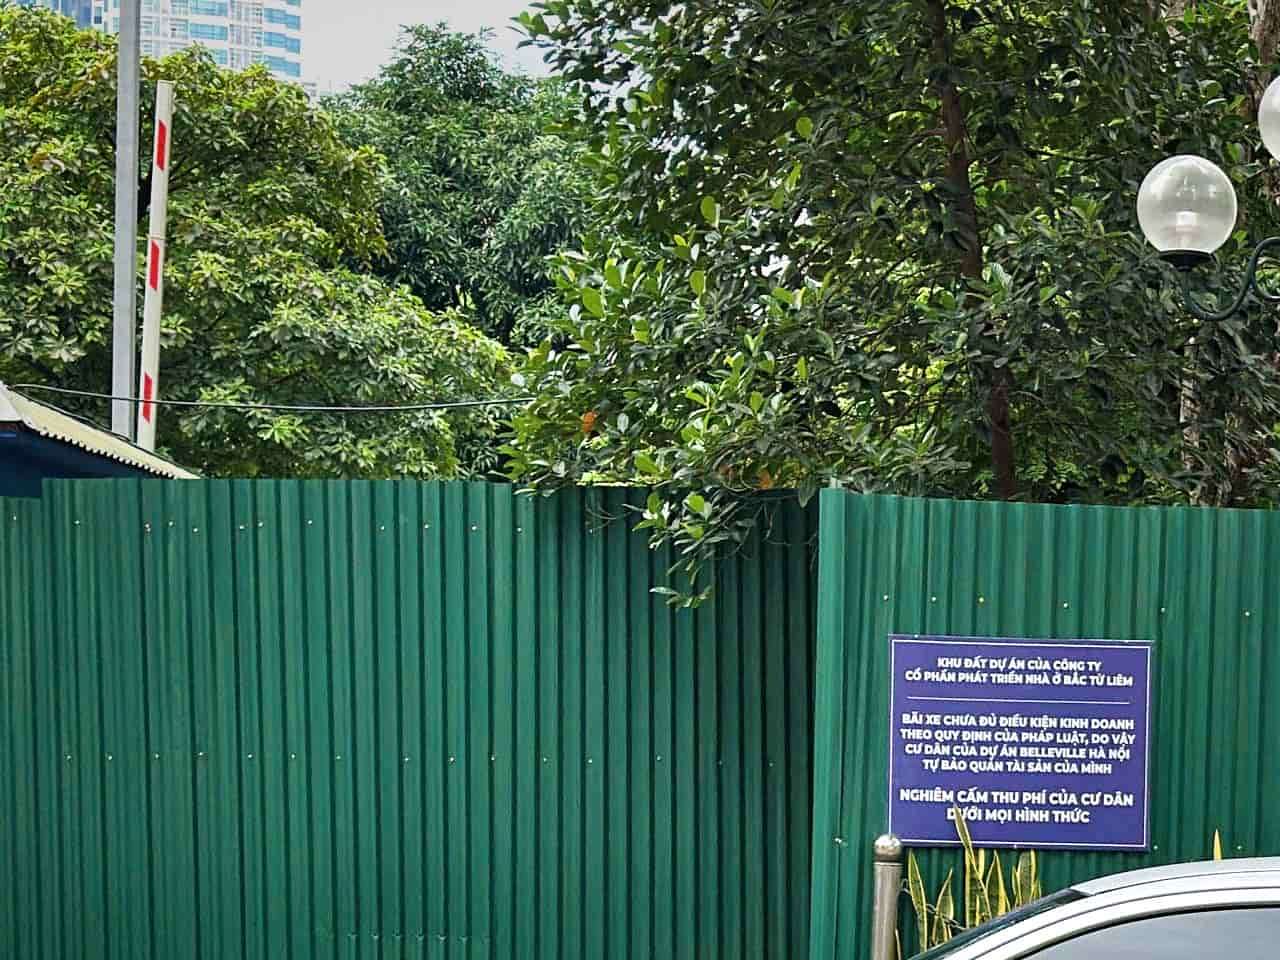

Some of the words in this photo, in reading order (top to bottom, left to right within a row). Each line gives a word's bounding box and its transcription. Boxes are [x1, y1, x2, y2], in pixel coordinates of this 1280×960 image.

[937, 657, 962, 668] KHU
[989, 658, 1007, 671] DỰ
[1008, 657, 1025, 670] ÁN
[1027, 656, 1051, 671] CỦA
[1053, 658, 1085, 671] CÔNG
[1087, 661, 1102, 671] TY
[958, 670, 988, 683] PHÁT
[1025, 671, 1050, 684] NHÀ
[1106, 673, 1133, 686] LIÊM
[902, 711, 923, 725] BÃI
[925, 714, 941, 725] XE
[943, 714, 977, 726] CHƯA
[979, 712, 997, 727] ĐỦ
[1029, 715, 1058, 730] KIỆN
[1060, 717, 1089, 729] KINH
[1091, 719, 1134, 730] DOANH
[900, 728, 932, 740] THEO
[934, 730, 960, 742] QUY
[961, 731, 992, 743] ĐỊNH
[994, 728, 1018, 742] CỦA
[1021, 729, 1054, 742] PHÁP
[1091, 733, 1110, 744] DO
[905, 743, 923, 755] CƯ
[924, 742, 950, 756] DÂN
[952, 741, 978, 757] CỦA
[979, 744, 999, 760] DỰ
[1000, 743, 1017, 757] ÁN
[1019, 746, 1086, 759] BELLEVILLE
[1088, 745, 1106, 760] HÀ
[1108, 744, 1130, 762] NỘI
[922, 758, 940, 773] TỰ
[941, 757, 967, 771] BẢO
[1006, 759, 1025, 772] TÀI
[1054, 759, 1079, 774] CỦA
[1080, 760, 1112, 774] MÌNH
[900, 786, 954, 802] NGHIÊM
[990, 791, 1019, 804] THU
[1022, 789, 1046, 805] PHÍ
[1048, 788, 1078, 805] CỦA
[1080, 791, 1102, 806] CƯ
[1103, 791, 1134, 806] DÂN
[984, 808, 1012, 824] MỌI
[1014, 806, 1050, 822] HÌNH
[1051, 807, 1091, 824] THỨC
